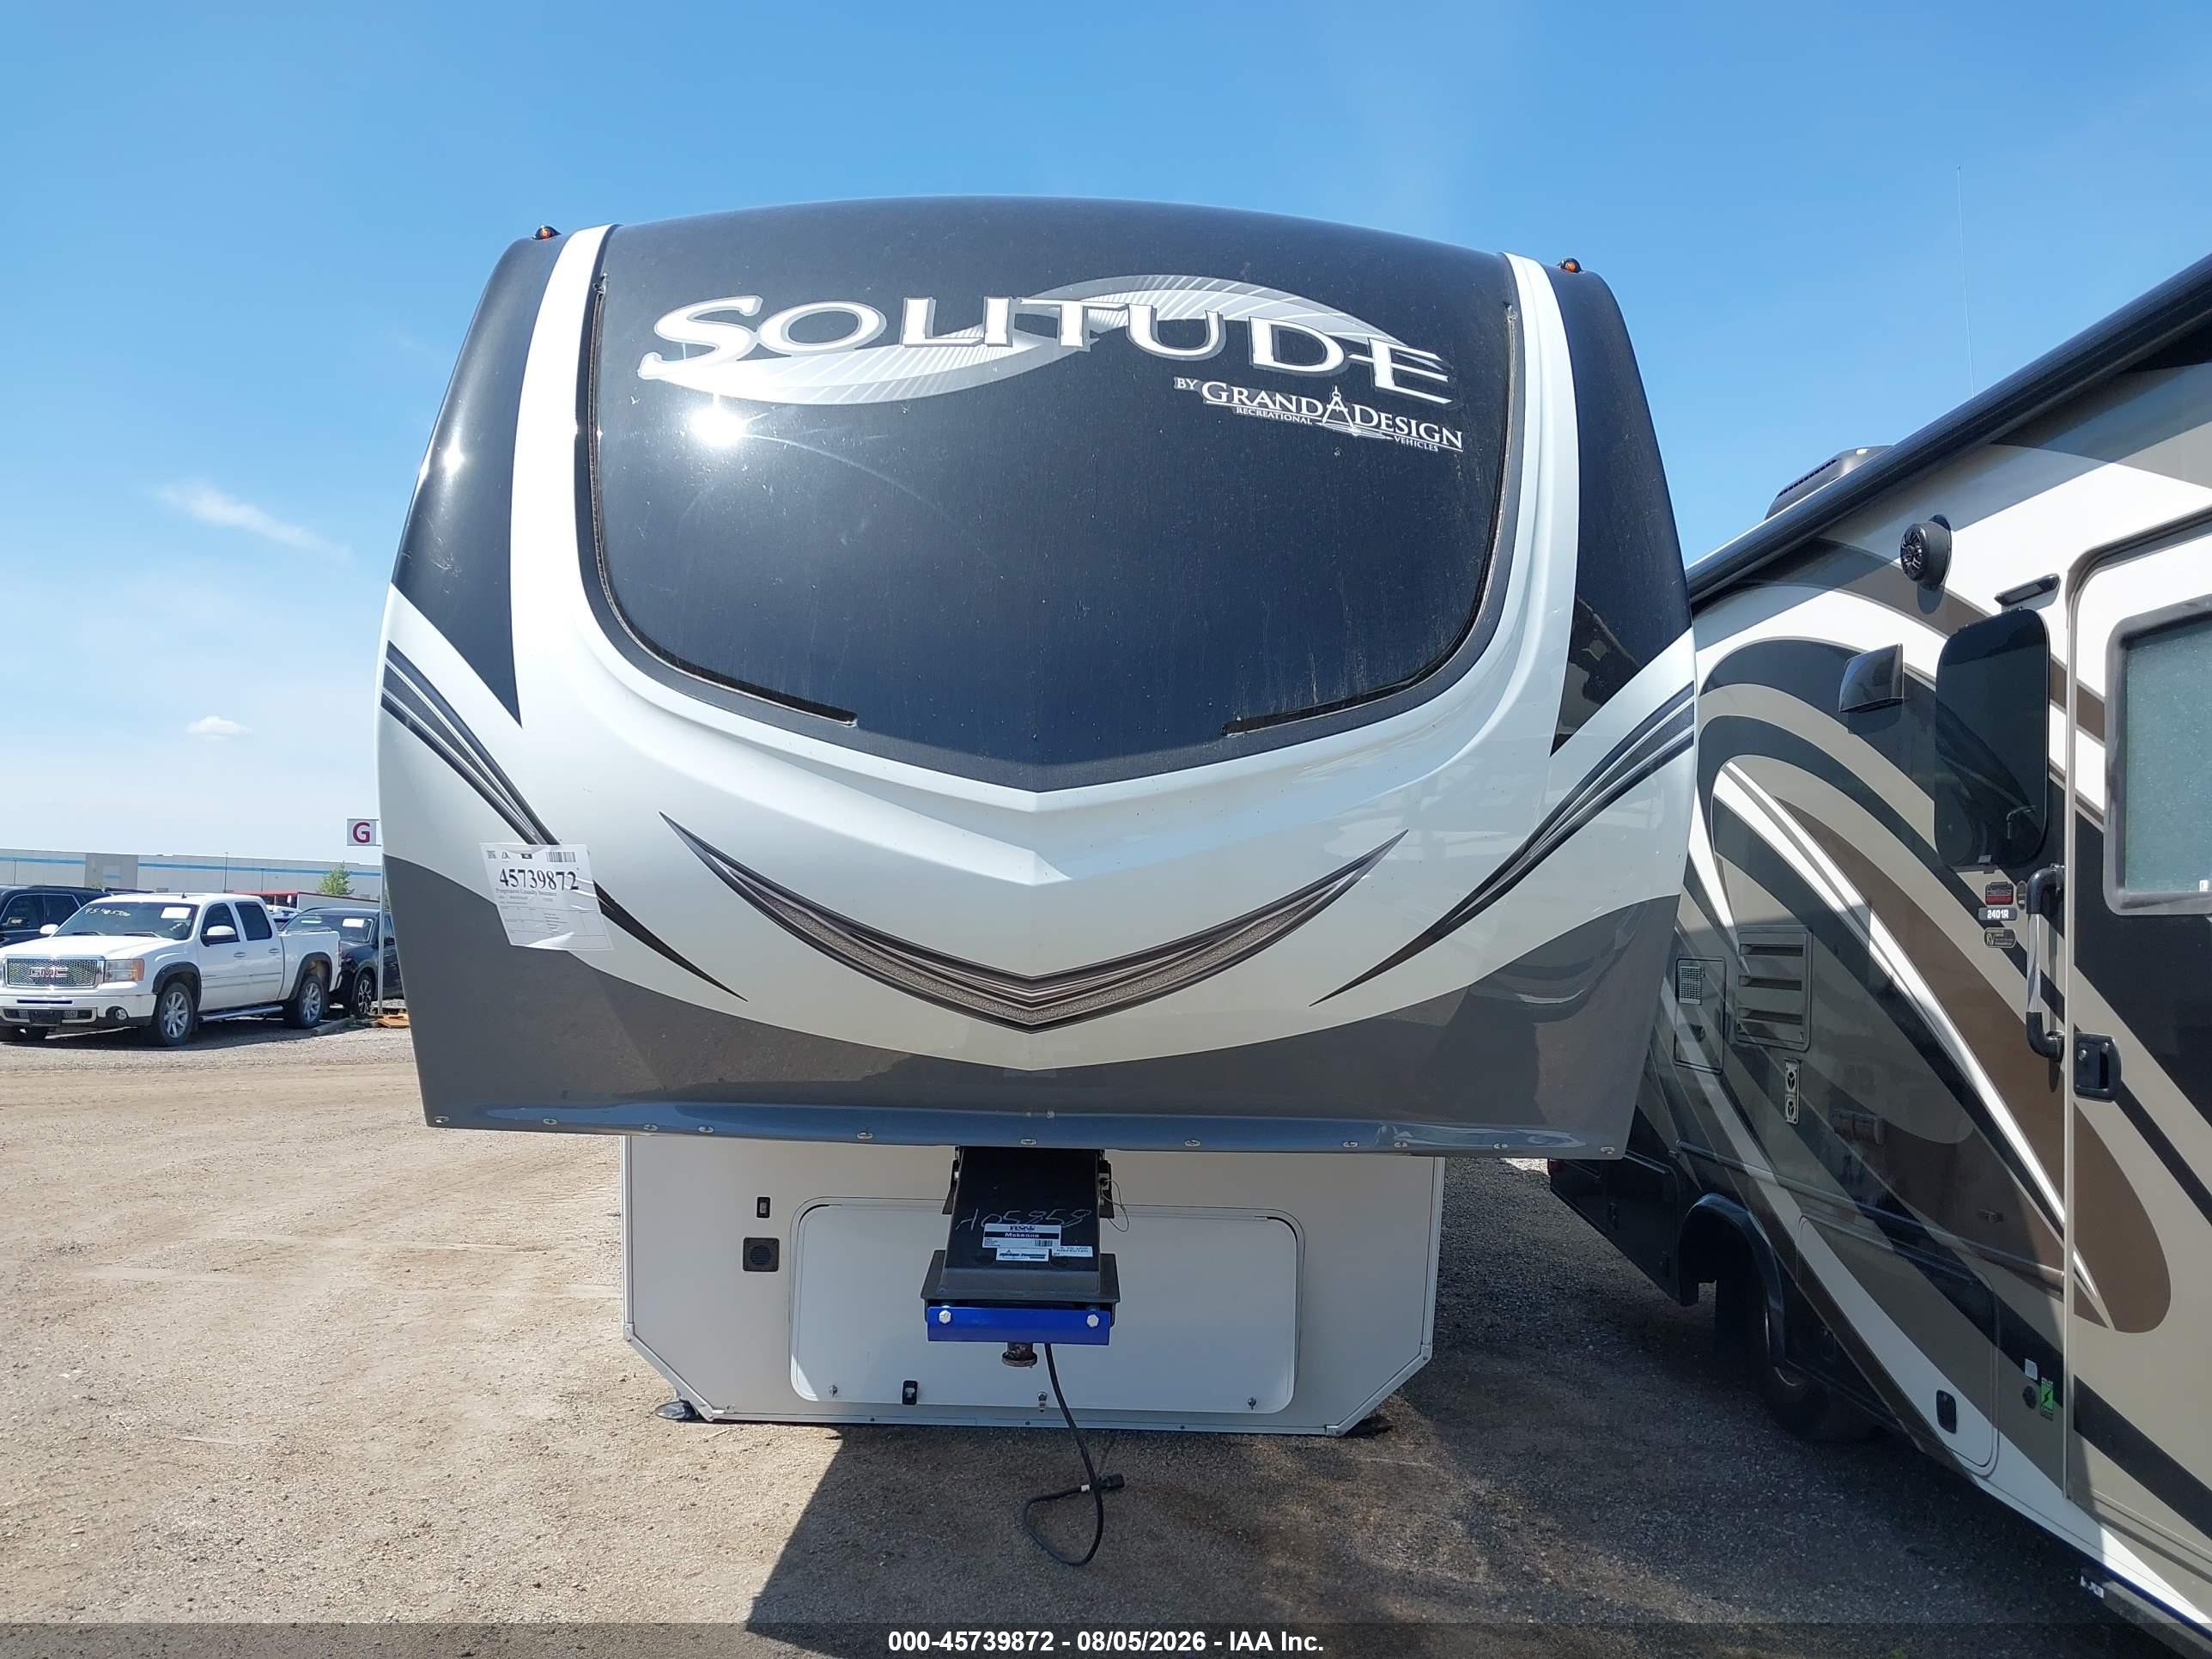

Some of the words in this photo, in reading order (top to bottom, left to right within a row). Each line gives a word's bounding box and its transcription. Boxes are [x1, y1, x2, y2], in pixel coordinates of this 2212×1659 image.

[637, 295, 1452, 405] SOLITUDE
[1174, 377, 1198, 391] BY
[1202, 381, 1323, 417] GRAND
[1352, 404, 1464, 449] DESIGN
[1235, 406, 1313, 426] RECREATIONAL
[1394, 435, 1439, 453] VEHICLES
[352, 822, 371, 844] G
[499, 868, 579, 890] 45739872
[1986, 909, 2009, 919] 2401R
[28, 967, 69, 977] GMC
